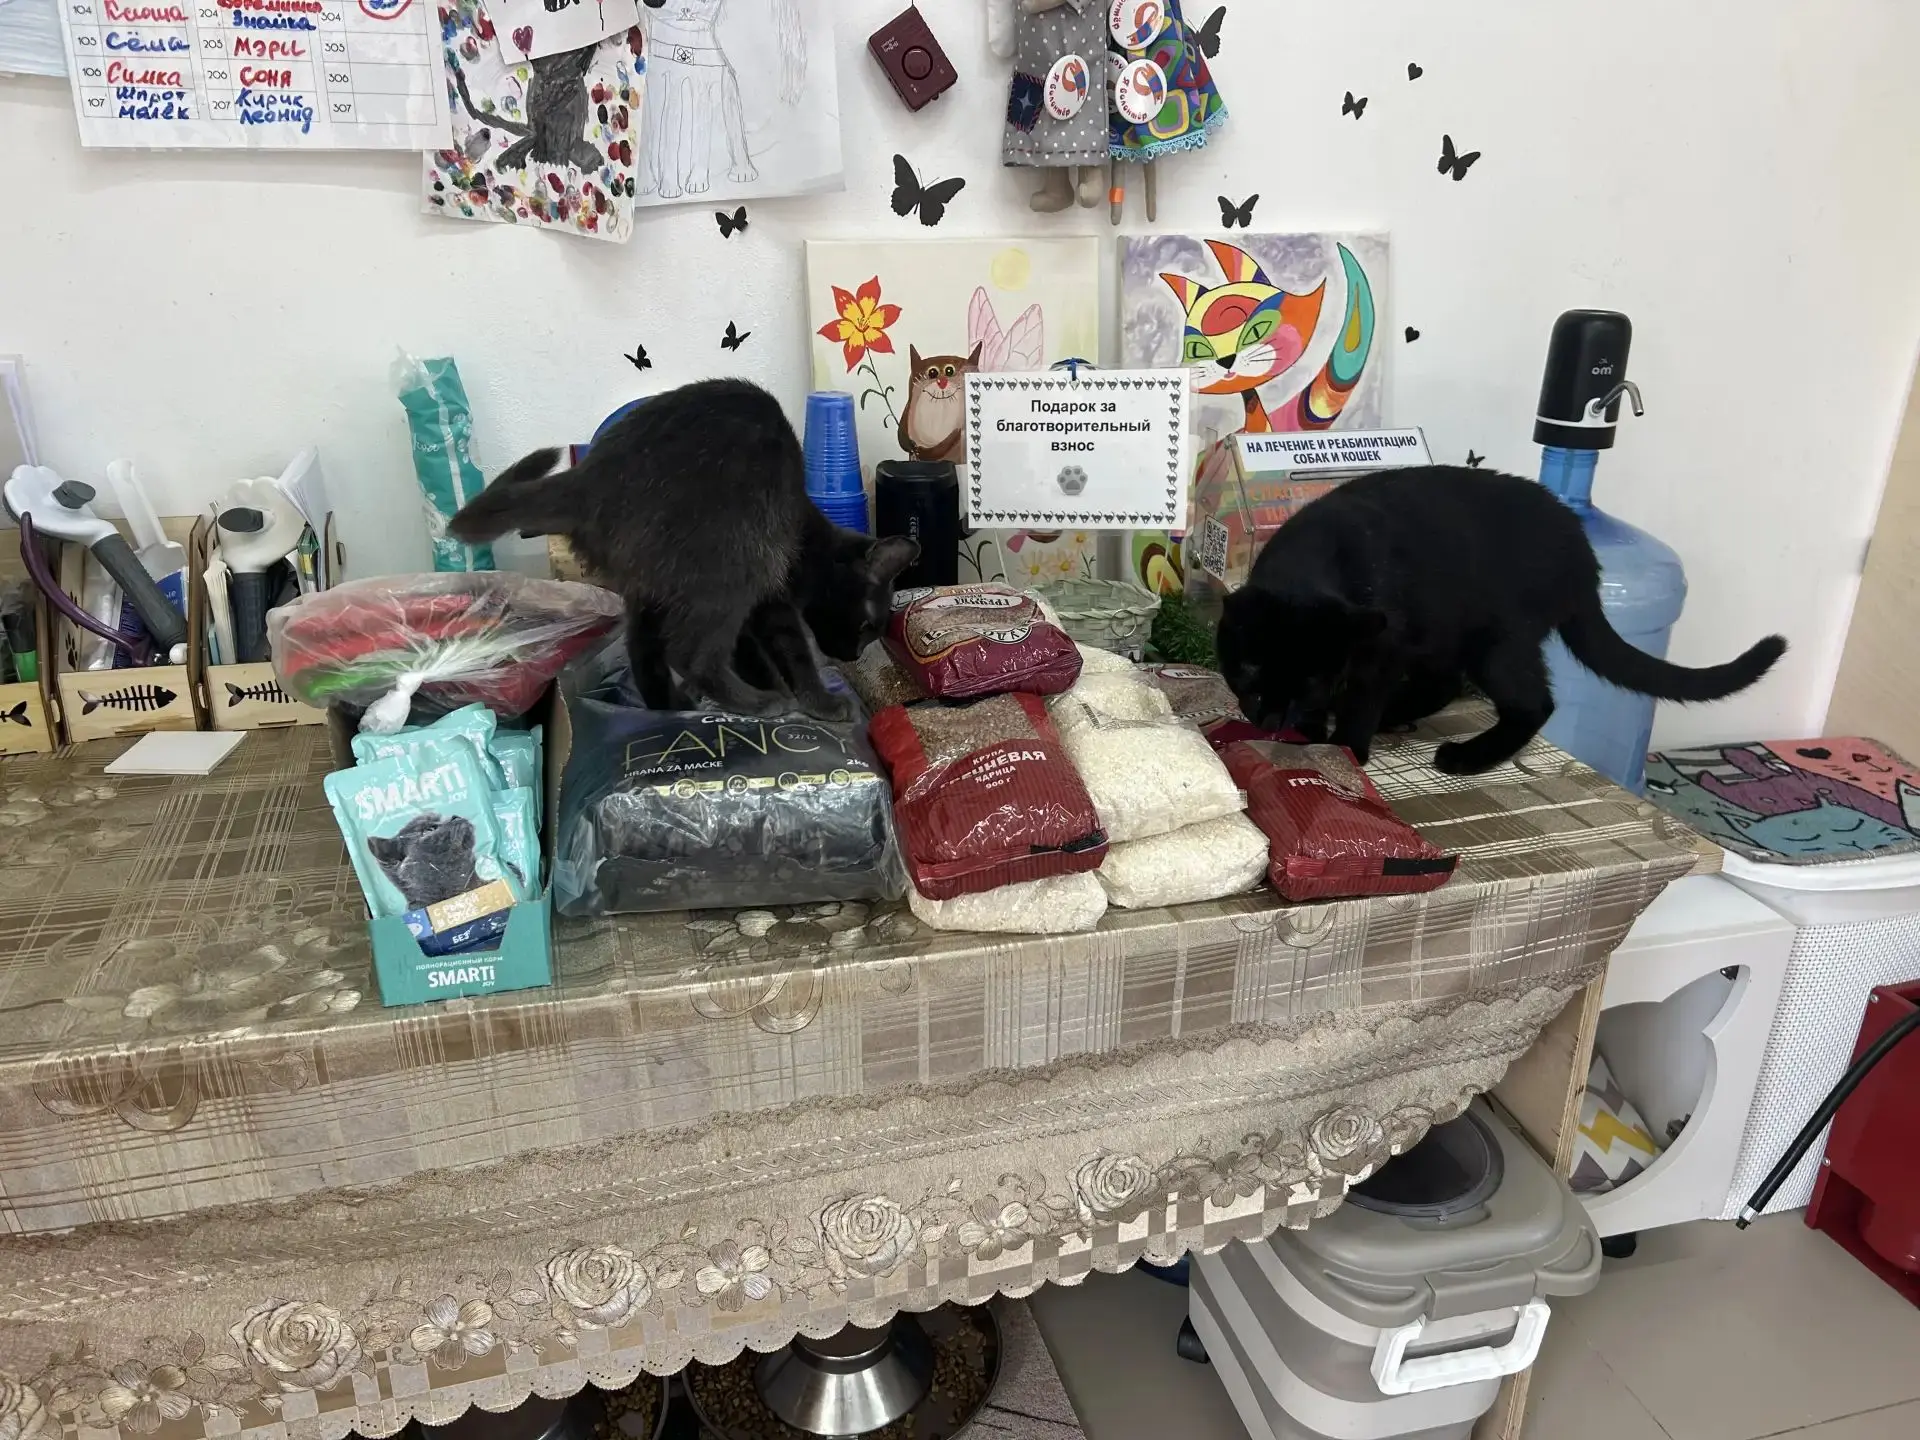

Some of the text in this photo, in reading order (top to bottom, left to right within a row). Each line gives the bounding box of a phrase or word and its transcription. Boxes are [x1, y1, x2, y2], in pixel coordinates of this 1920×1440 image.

[73, 5, 92, 15] 104
[200, 8, 218, 18] 204
[233, 9, 317, 31] Знайка
[321, 11, 341, 22] 304
[77, 36, 97, 46] 105
[106, 31, 190, 52] Сёма
[203, 39, 223, 49] 205
[324, 42, 345, 53] 305
[82, 67, 102, 77] 106
[107, 61, 183, 88] Симка
[208, 70, 228, 80] 206
[328, 73, 349, 83] 306
[88, 98, 105, 108] 107
[235, 87, 303, 111] Кирик
[213, 100, 230, 111] 207
[333, 103, 351, 113] 307
[1030, 399, 1117, 416] Подарок за
[996, 418, 1151, 433] благотворительный
[1050, 440, 1095, 452] взнос
[1246, 435, 1417, 453] НА ЛЕЧЕНИЕ И РЕАБИЛИТАЦИЮ
[1293, 450, 1382, 464] СОБАК И КОШЕК
[972, 748, 1005, 766] КРУПА
[666, 764, 682, 772] ZA
[974, 765, 1017, 784] ЯДРИЦА
[985, 779, 1005, 789] 900
